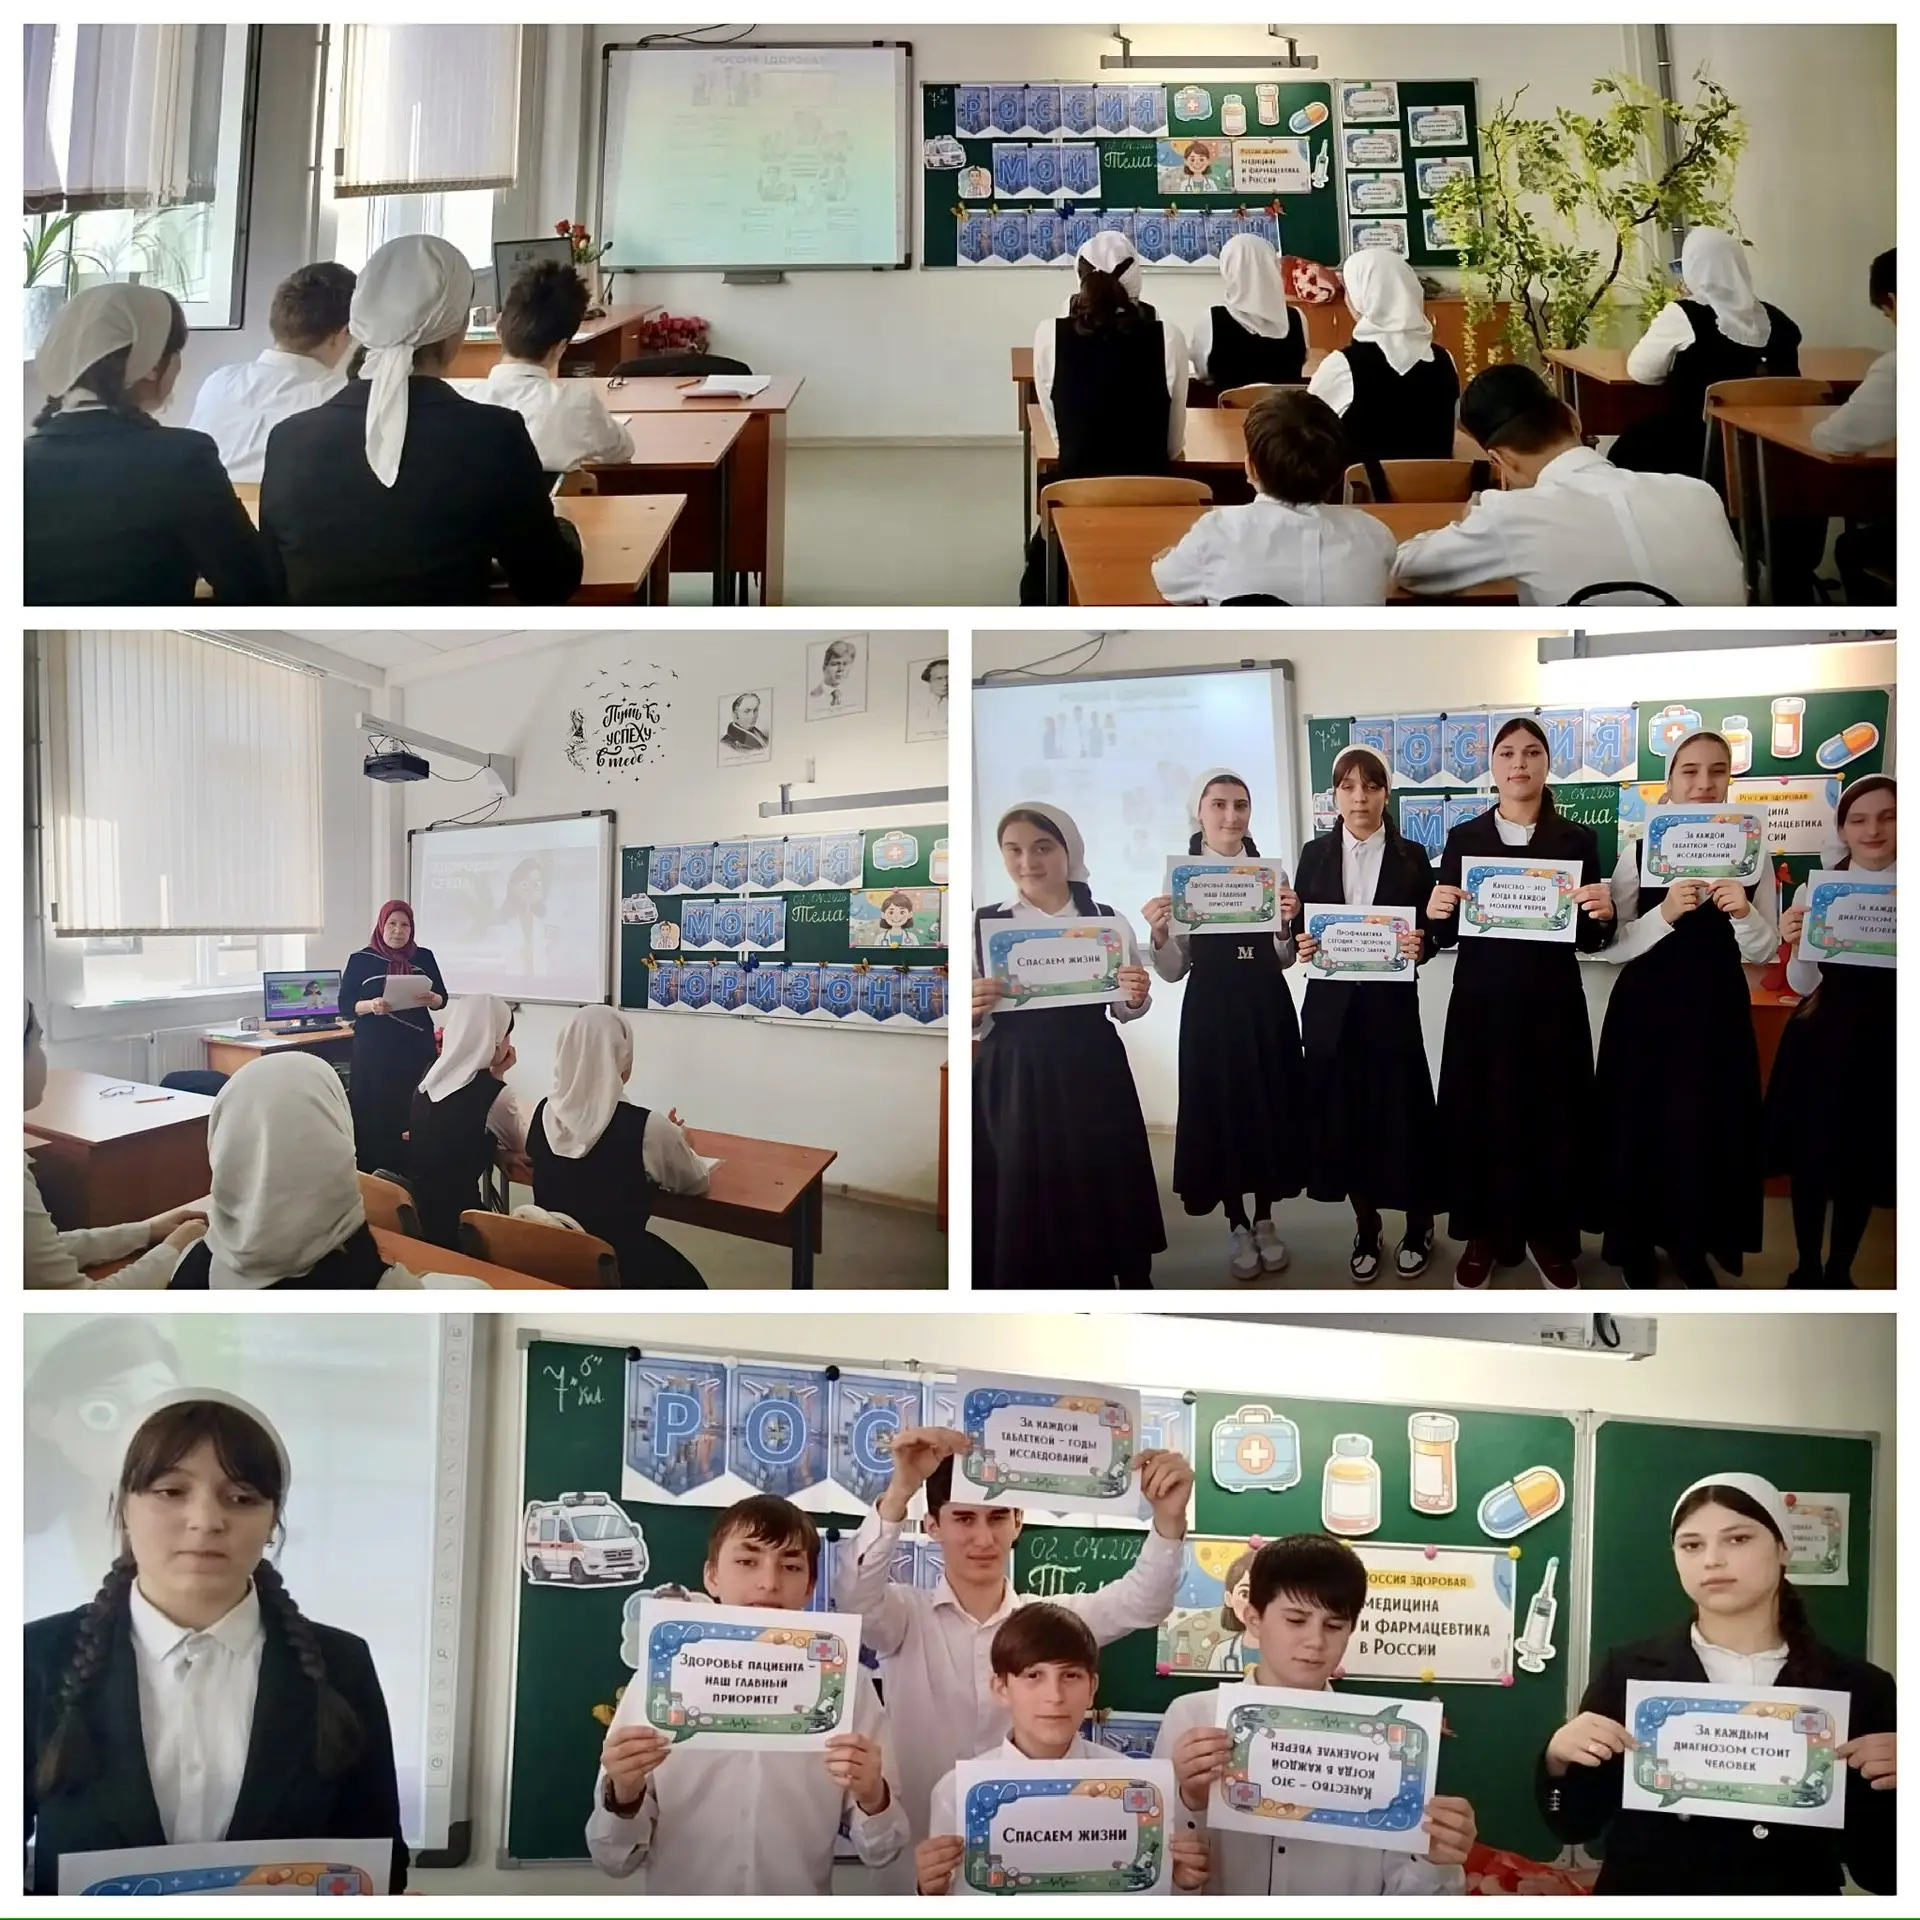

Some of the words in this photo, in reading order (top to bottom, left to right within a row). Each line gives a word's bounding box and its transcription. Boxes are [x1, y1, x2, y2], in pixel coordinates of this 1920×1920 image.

[964, 96, 1158, 121] РОССИЯ
[999, 157, 1091, 182] МОИ
[1553, 785, 1616, 802] 2.04.2026
[1768, 820, 1823, 829] МАЦЕВТИКА
[1767, 833, 1787, 841] СИИ
[657, 847, 851, 881] РОССИЯ
[684, 910, 777, 937] МОИ
[1030, 1536, 1141, 1560] 02.04.202
[1368, 1573, 1406, 1585] ОССИЯ
